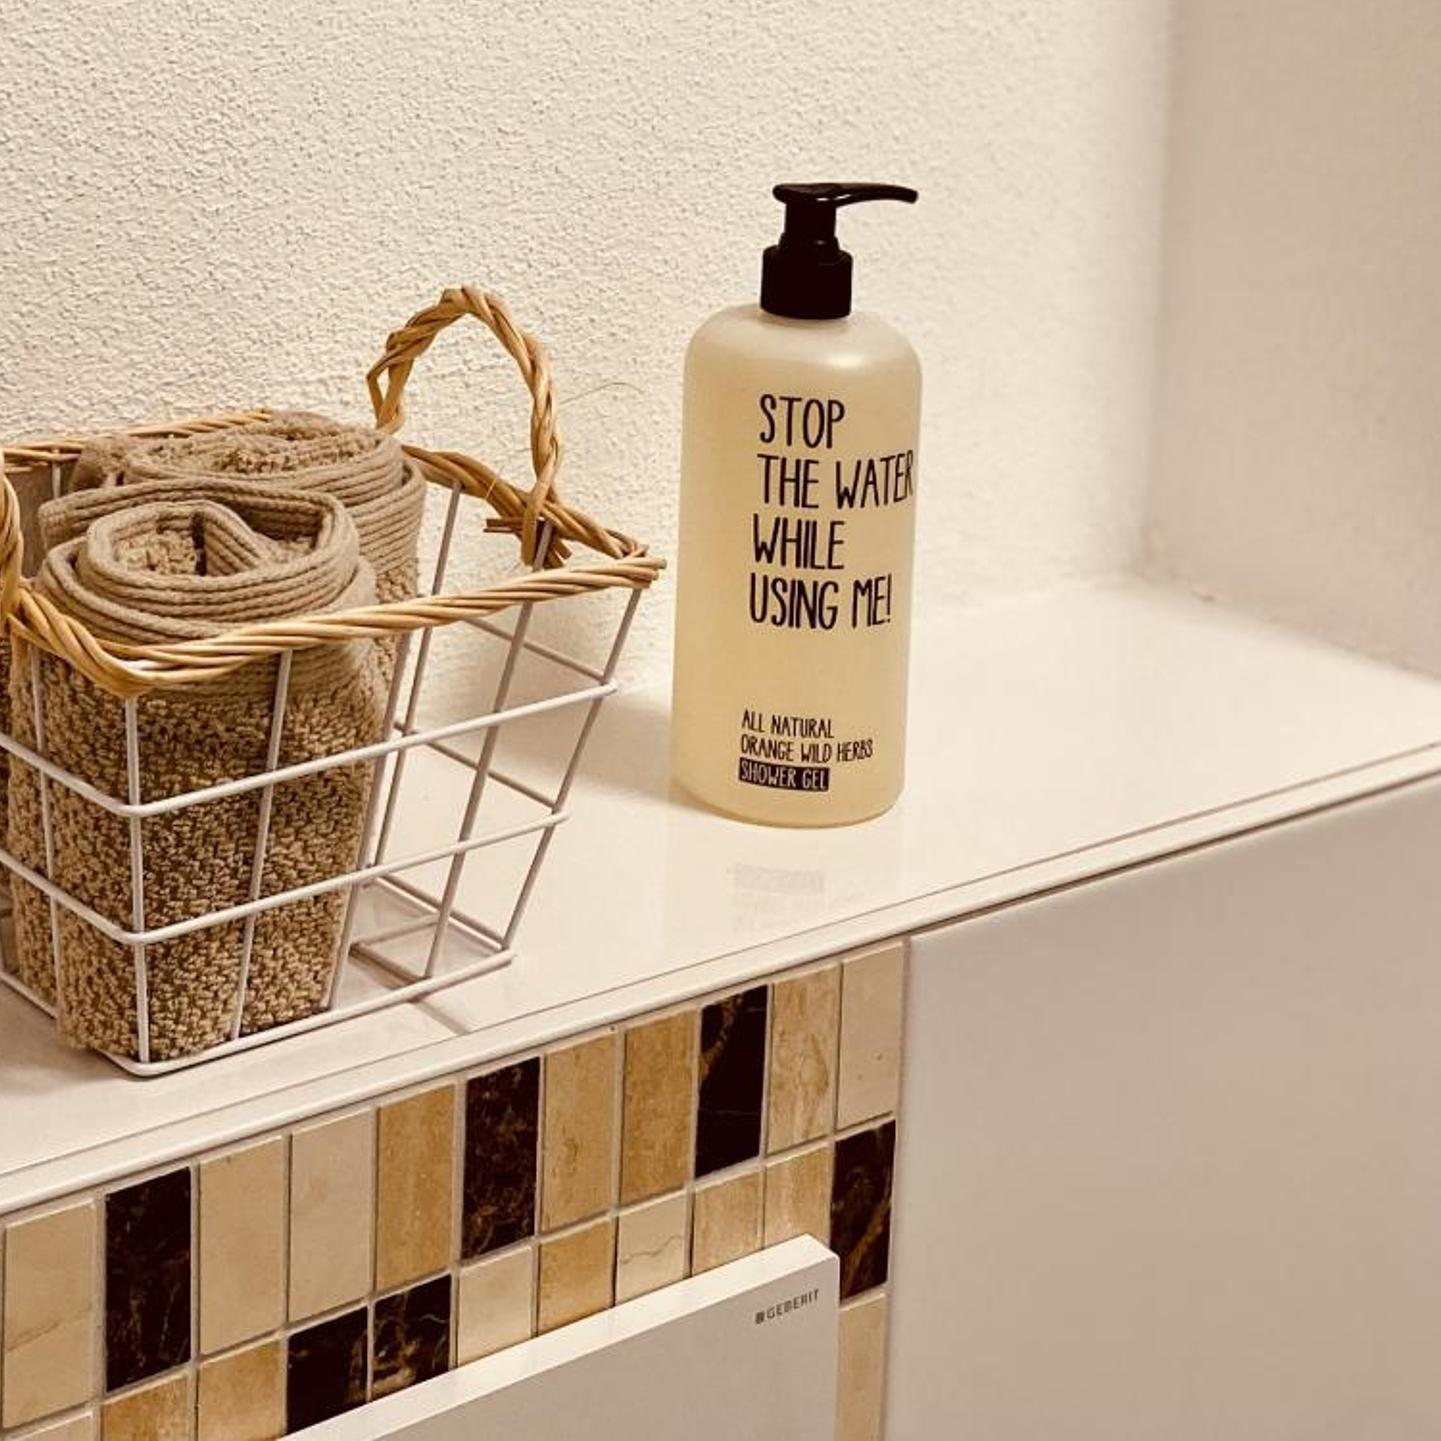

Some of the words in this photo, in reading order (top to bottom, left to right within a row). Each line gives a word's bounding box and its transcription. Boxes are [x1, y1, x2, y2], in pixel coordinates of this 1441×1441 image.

[759, 394, 845, 449] STOP
[757, 454, 820, 508] THE
[836, 449, 914, 509] WATER
[753, 513, 845, 570] WHILE
[750, 572, 839, 630] USING
[851, 573, 892, 629] ME!
[741, 709, 765, 733] ALL
[771, 714, 835, 738] NATURAL
[740, 734, 794, 762] ORANGE
[801, 743, 833, 764] WILD
[836, 739, 874, 763] HERBS
[741, 761, 796, 788] SHOWER
[802, 768, 827, 790] GEL
[766, 1288, 819, 1320] GEBERIT
